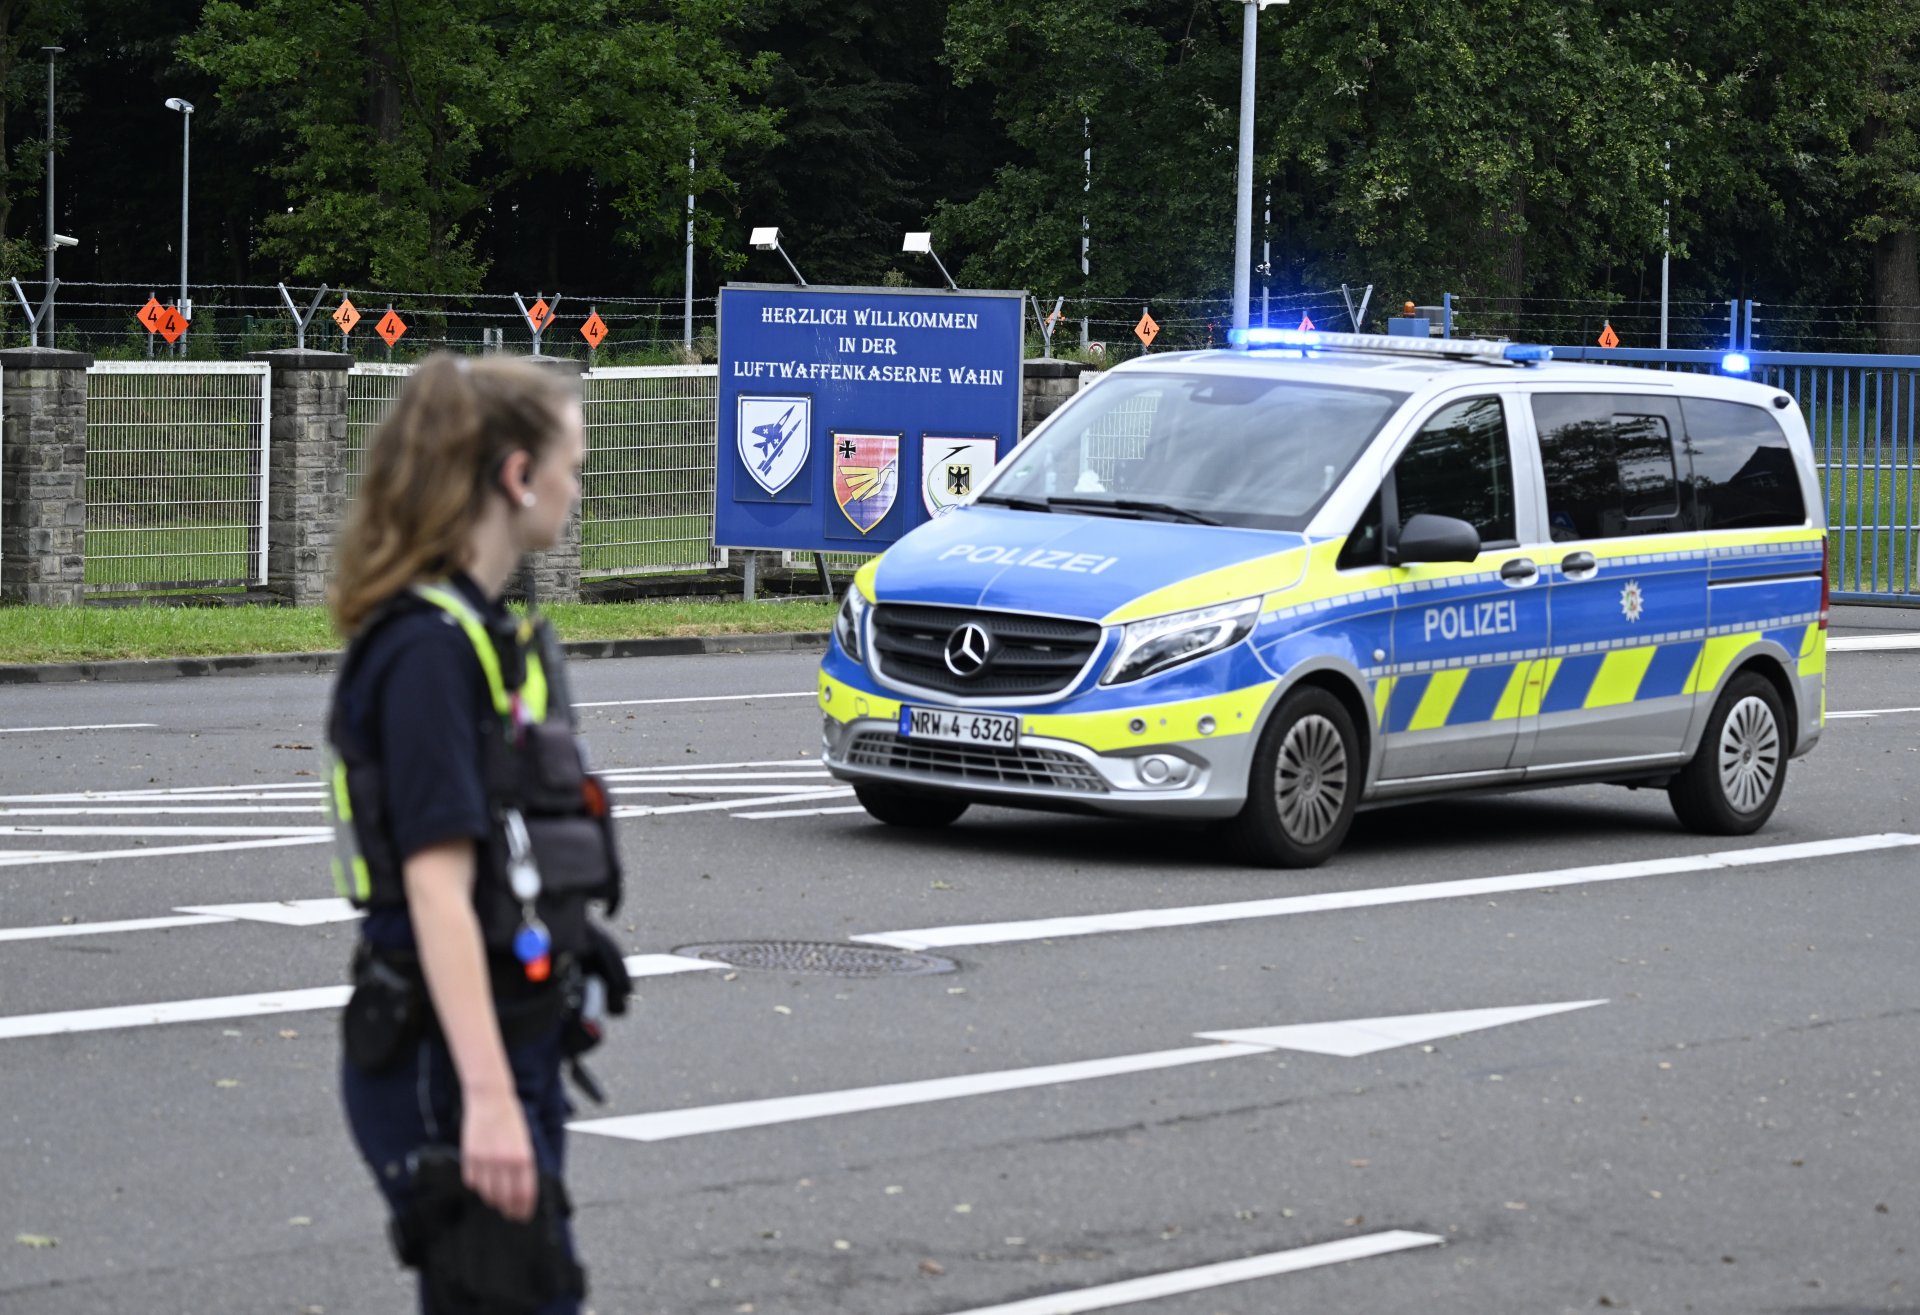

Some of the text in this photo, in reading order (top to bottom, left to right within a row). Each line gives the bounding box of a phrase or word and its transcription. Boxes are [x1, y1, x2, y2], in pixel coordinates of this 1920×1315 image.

[147, 306, 157, 323] 4
[342, 308, 350, 323] 4
[535, 307, 544, 322] 4
[762, 307, 978, 330] HERZLICH WILLKOMMEN
[165, 315, 176, 332] 4
[385, 318, 395, 336] 4
[590, 321, 598, 338] 4
[1142, 321, 1150, 336] 4
[838, 337, 898, 355] IN DER
[1605, 332, 1612, 348] 4
[733, 360, 1004, 386] LUFTWAFFENKASERNE WAHN
[937, 544, 1119, 575] POLIZEI
[1424, 600, 1517, 642] POLIZEI
[910, 711, 942, 736] NRW
